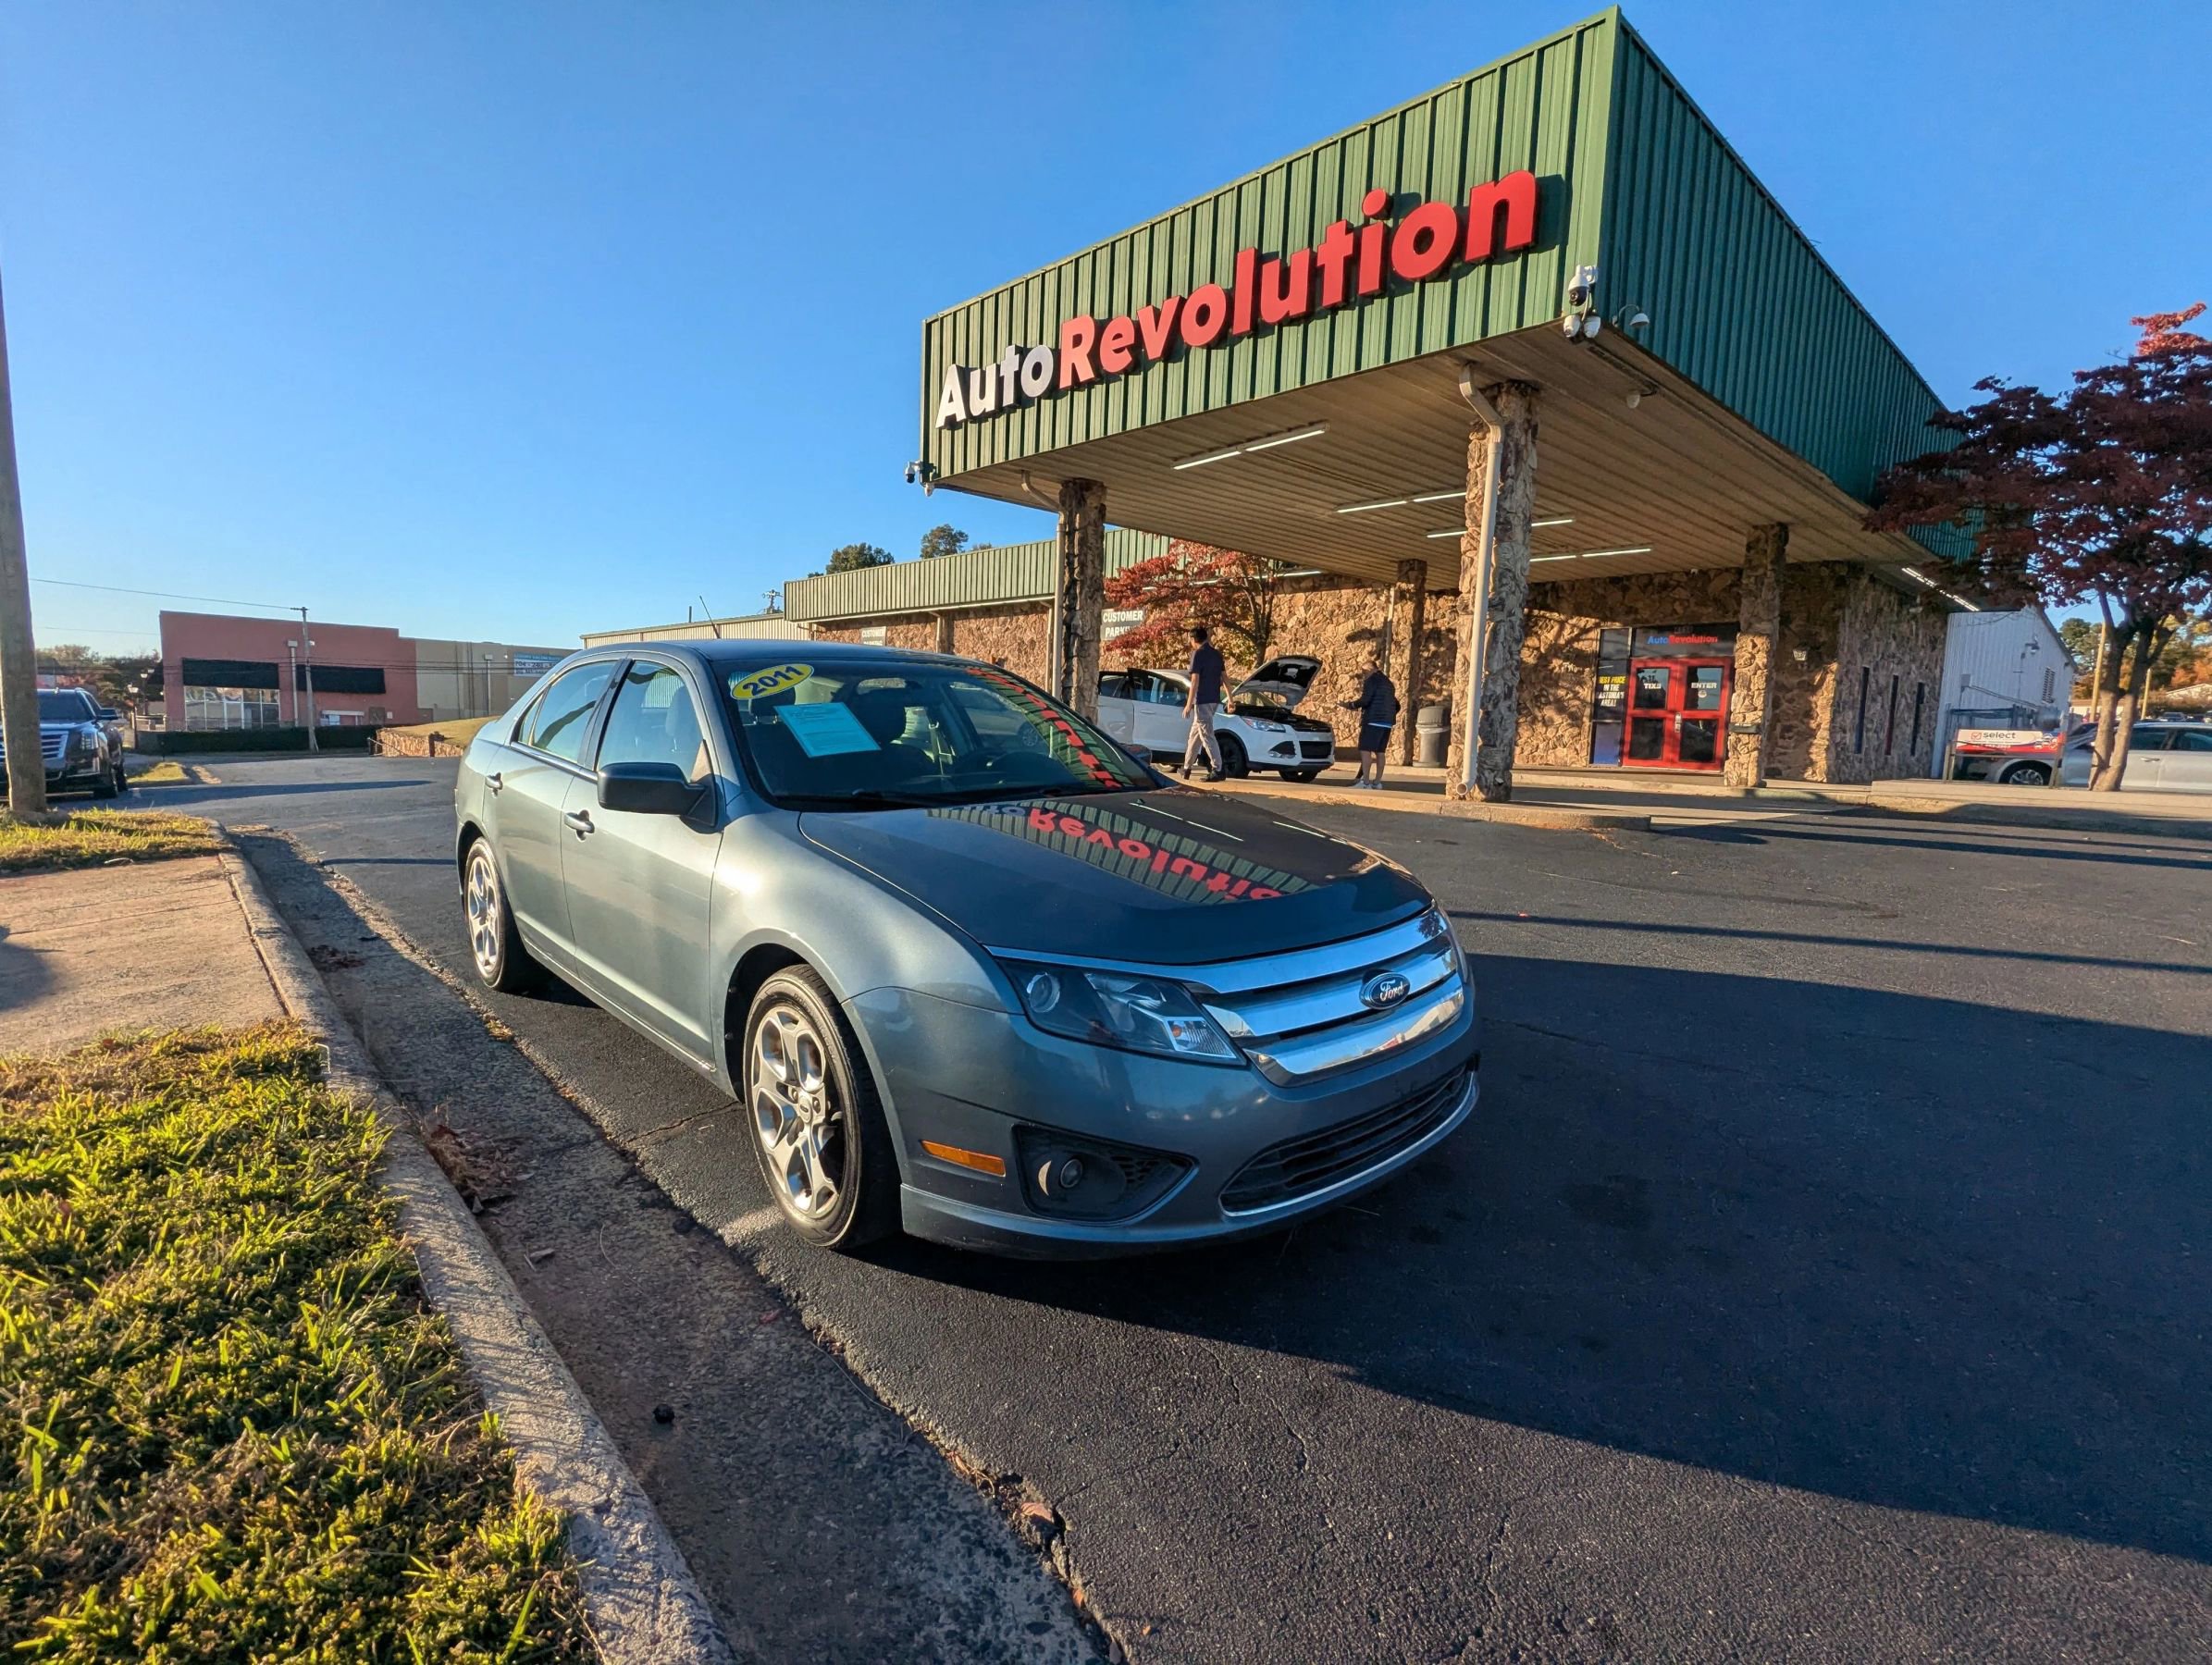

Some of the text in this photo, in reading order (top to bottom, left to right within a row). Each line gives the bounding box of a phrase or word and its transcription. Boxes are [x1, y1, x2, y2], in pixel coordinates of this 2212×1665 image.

[934, 169, 1540, 430] AutoRevolution
[1103, 610, 1143, 623] CUSTOMER
[742, 666, 805, 696] 2011
[1596, 691, 1625, 699] ASTONIA'S
[1983, 731, 2017, 739] select
[1379, 979, 1404, 1002] Ford
